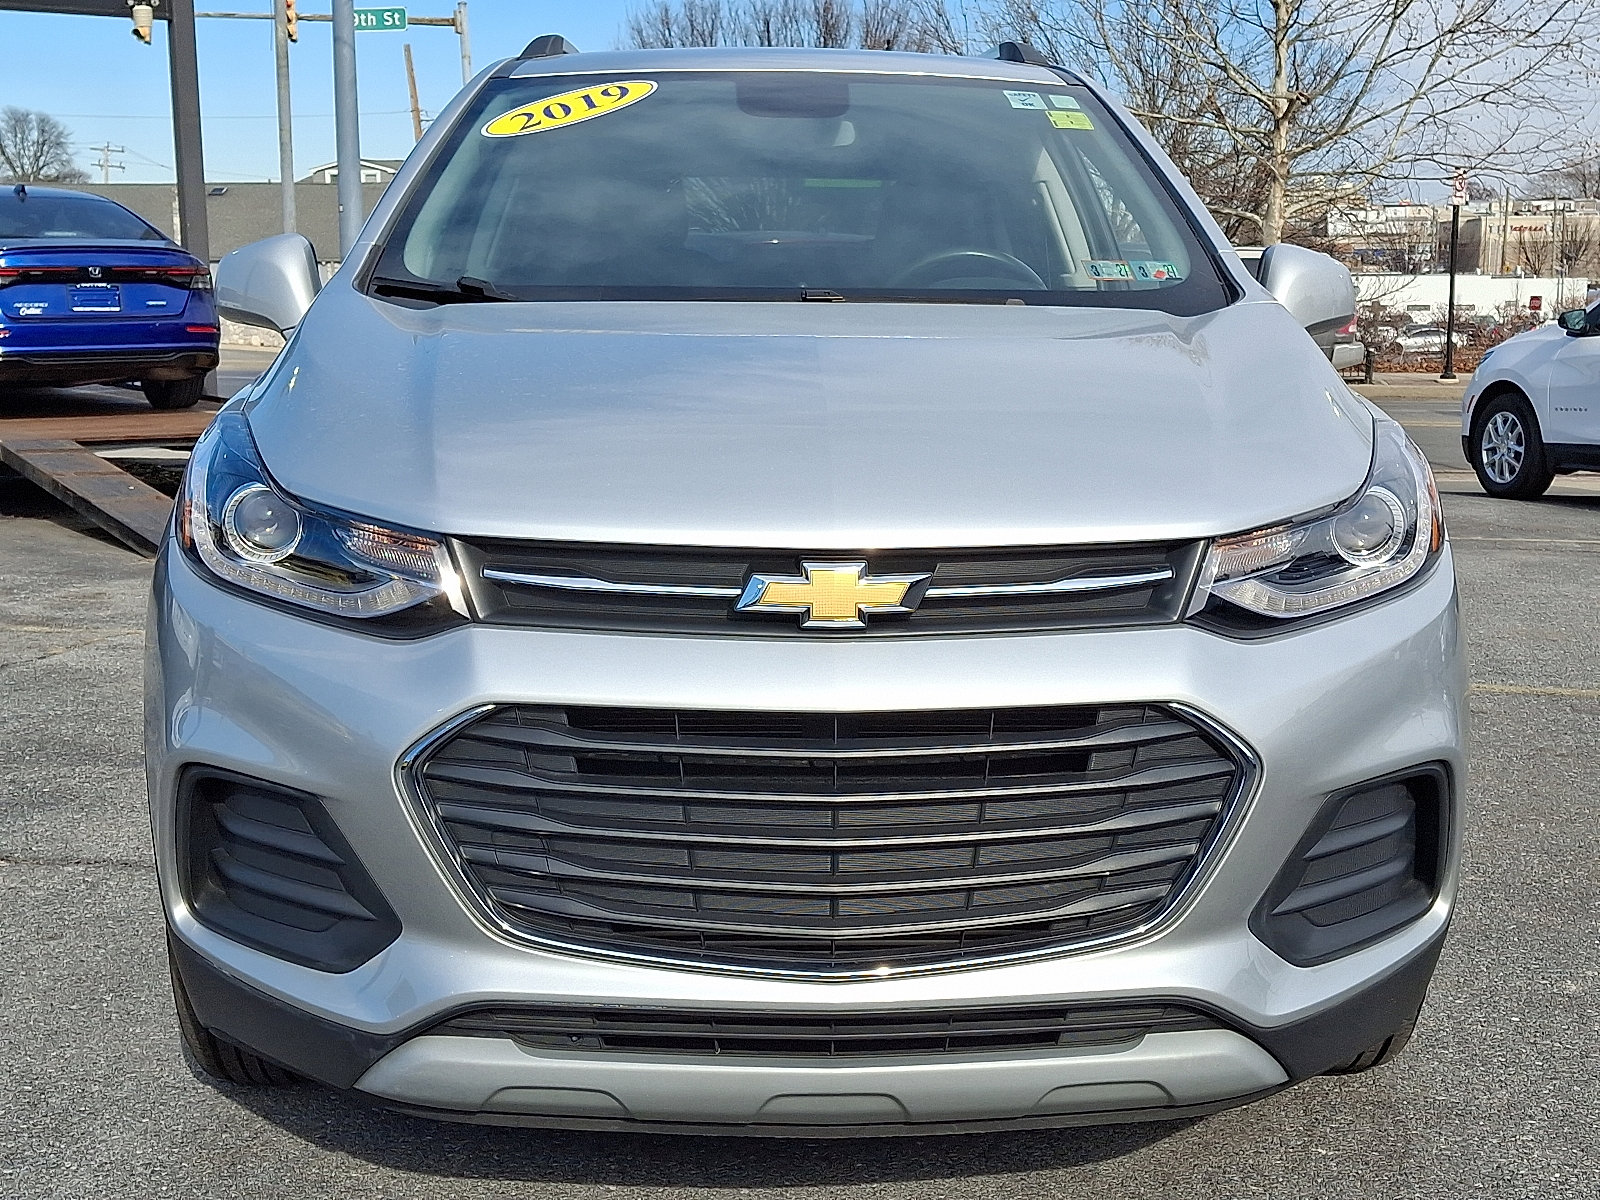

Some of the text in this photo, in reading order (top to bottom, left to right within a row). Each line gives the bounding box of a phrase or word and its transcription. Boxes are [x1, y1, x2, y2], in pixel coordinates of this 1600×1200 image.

[383, 11, 400, 26] St
[509, 85, 630, 132] 2019
[1090, 264, 1101, 277] 3
[1138, 265, 1150, 279] 3
